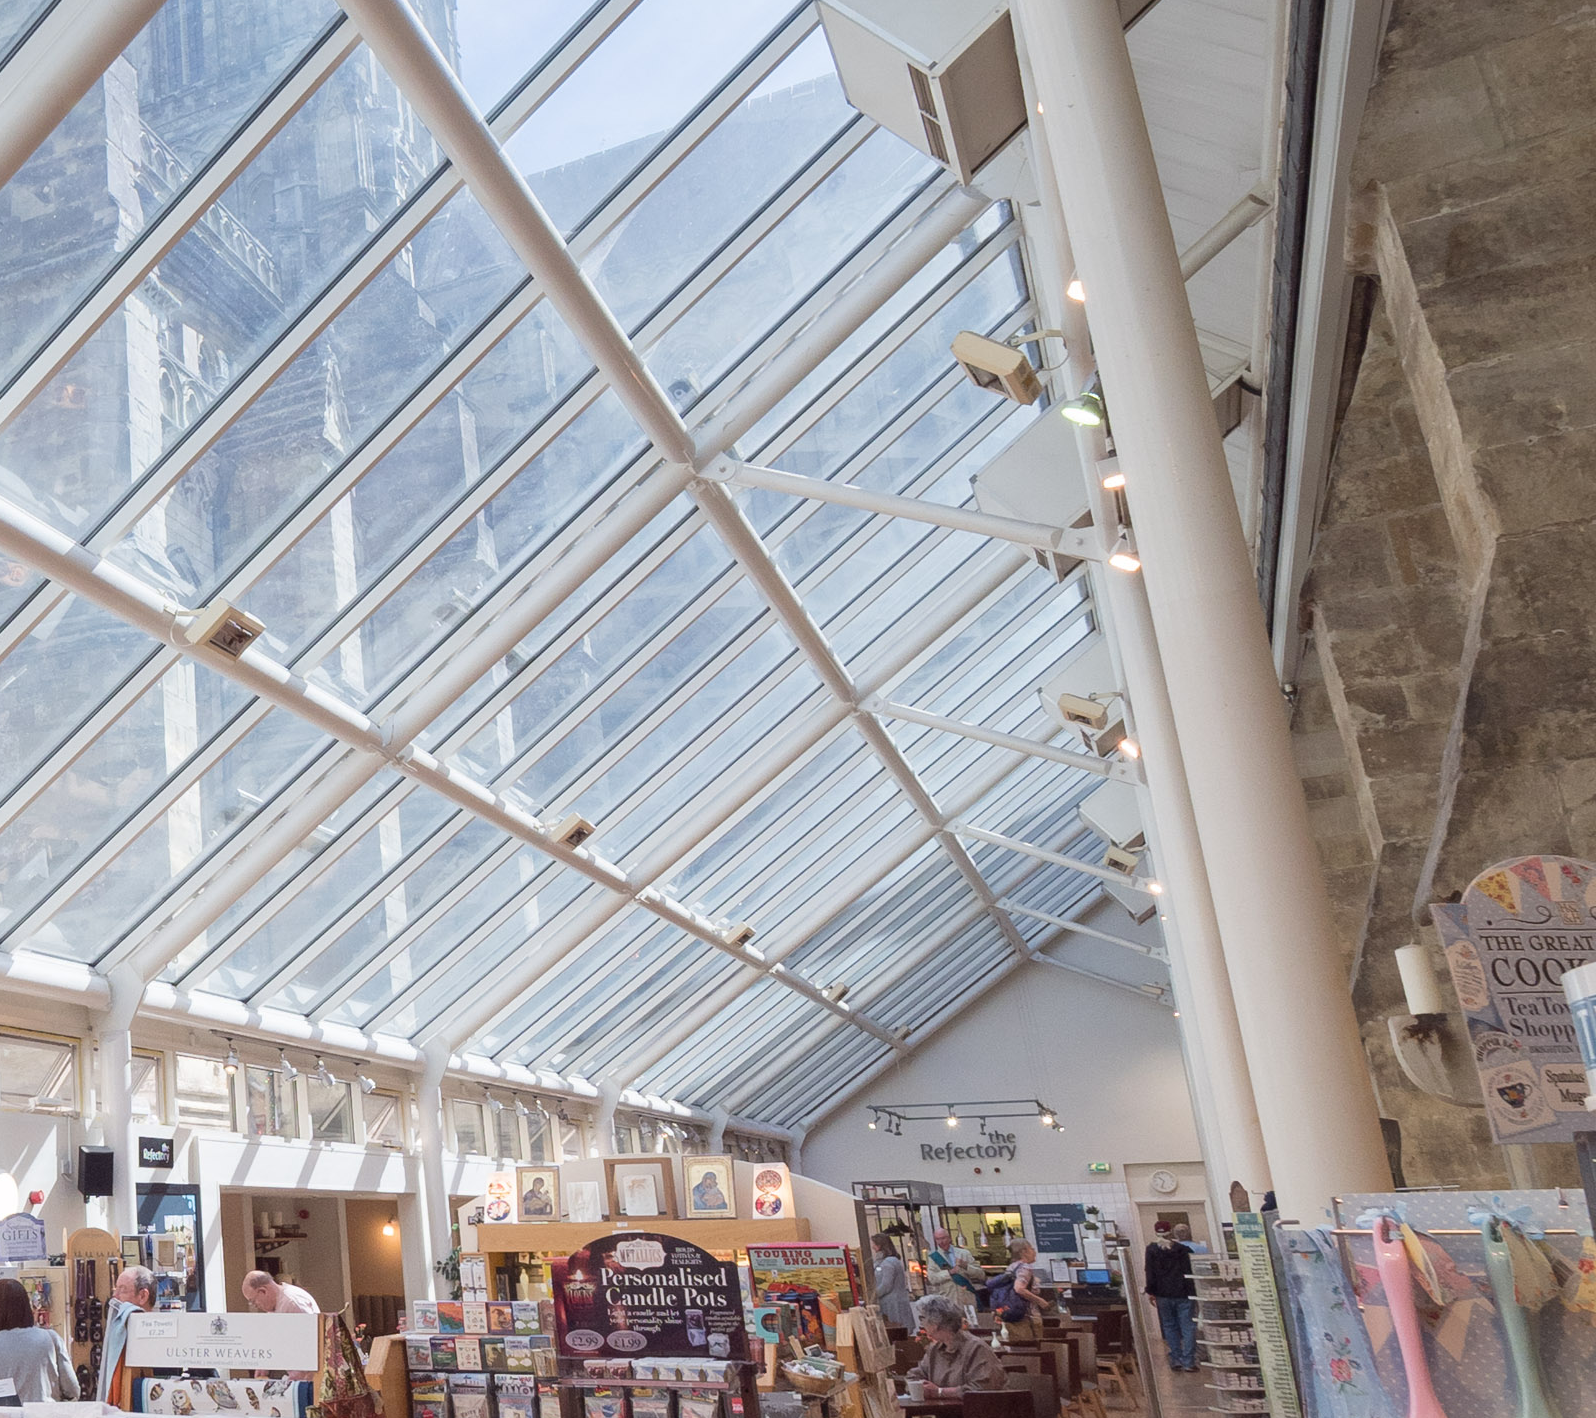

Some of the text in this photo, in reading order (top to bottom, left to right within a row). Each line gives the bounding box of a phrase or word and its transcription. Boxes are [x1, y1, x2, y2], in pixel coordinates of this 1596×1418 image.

[1480, 935, 1596, 951] THE GREAT
[989, 1130, 1017, 1144] the
[143, 1148, 170, 1163] Refectory
[920, 1142, 1017, 1162] Refectory
[754, 1250, 812, 1258] TOURING
[784, 1257, 844, 1266] ENGLAND
[600, 1267, 728, 1287] Personalised
[605, 1288, 677, 1307] Candle
[684, 1288, 728, 1307] Pots
[571, 1336, 599, 1346] £2.99
[614, 1338, 642, 1348] £1.99
[166, 1347, 273, 1359] ULSTER WEAVERS
